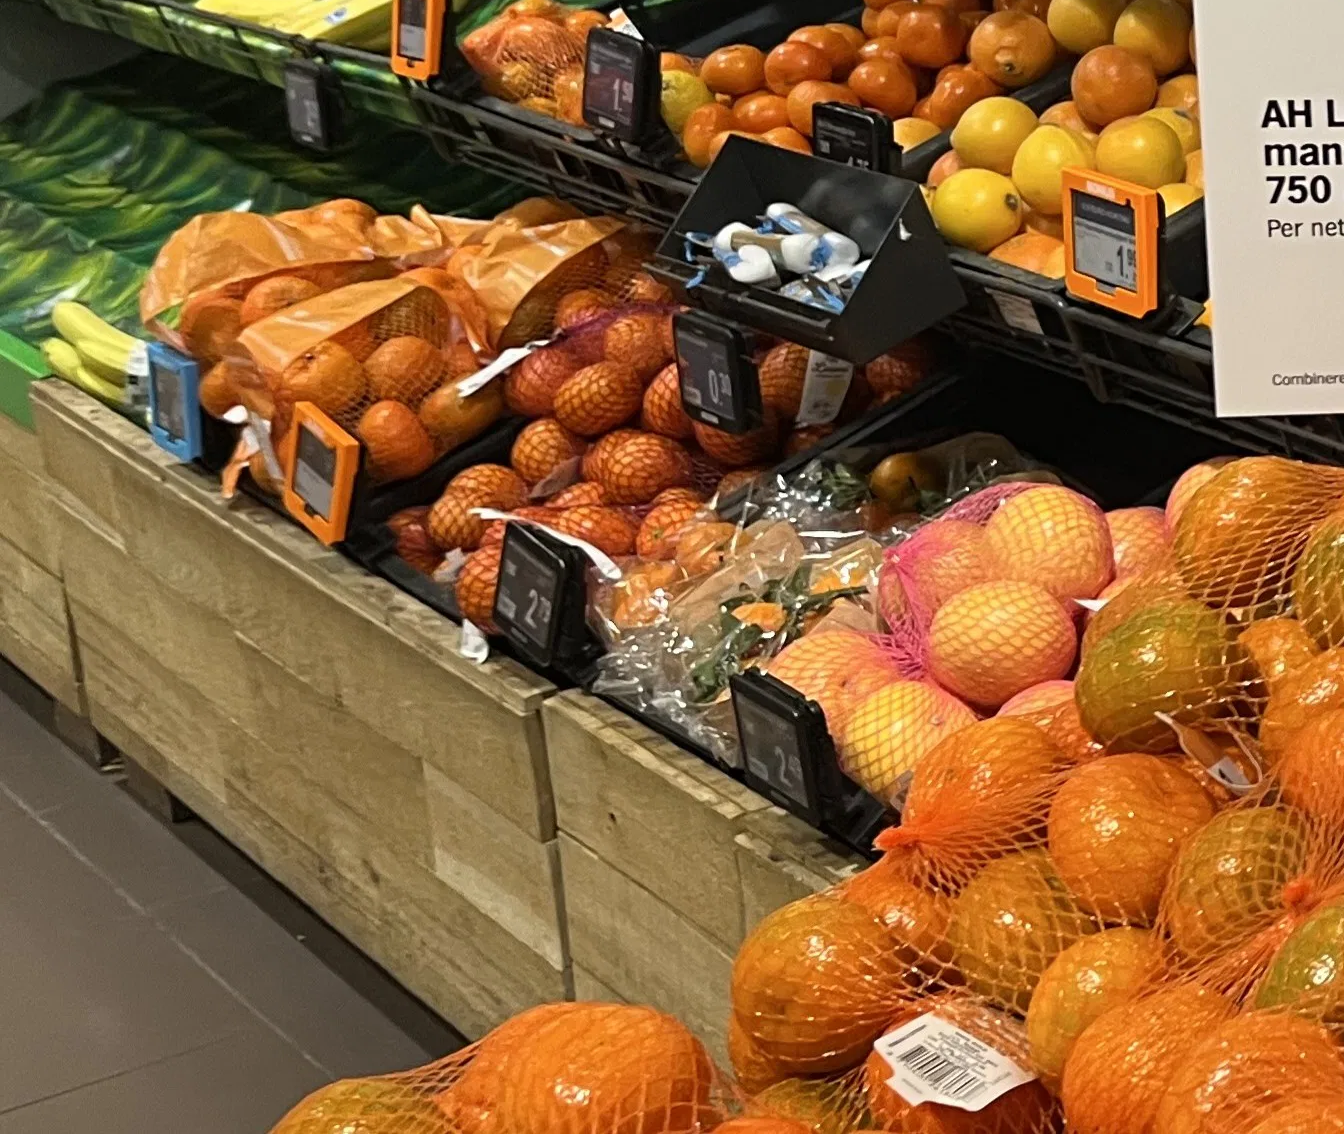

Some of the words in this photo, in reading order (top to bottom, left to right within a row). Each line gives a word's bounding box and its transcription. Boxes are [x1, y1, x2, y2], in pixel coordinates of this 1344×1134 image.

[1261, 99, 1313, 128] AH
[1266, 175, 1332, 204] 750
[1267, 219, 1303, 238] Per
